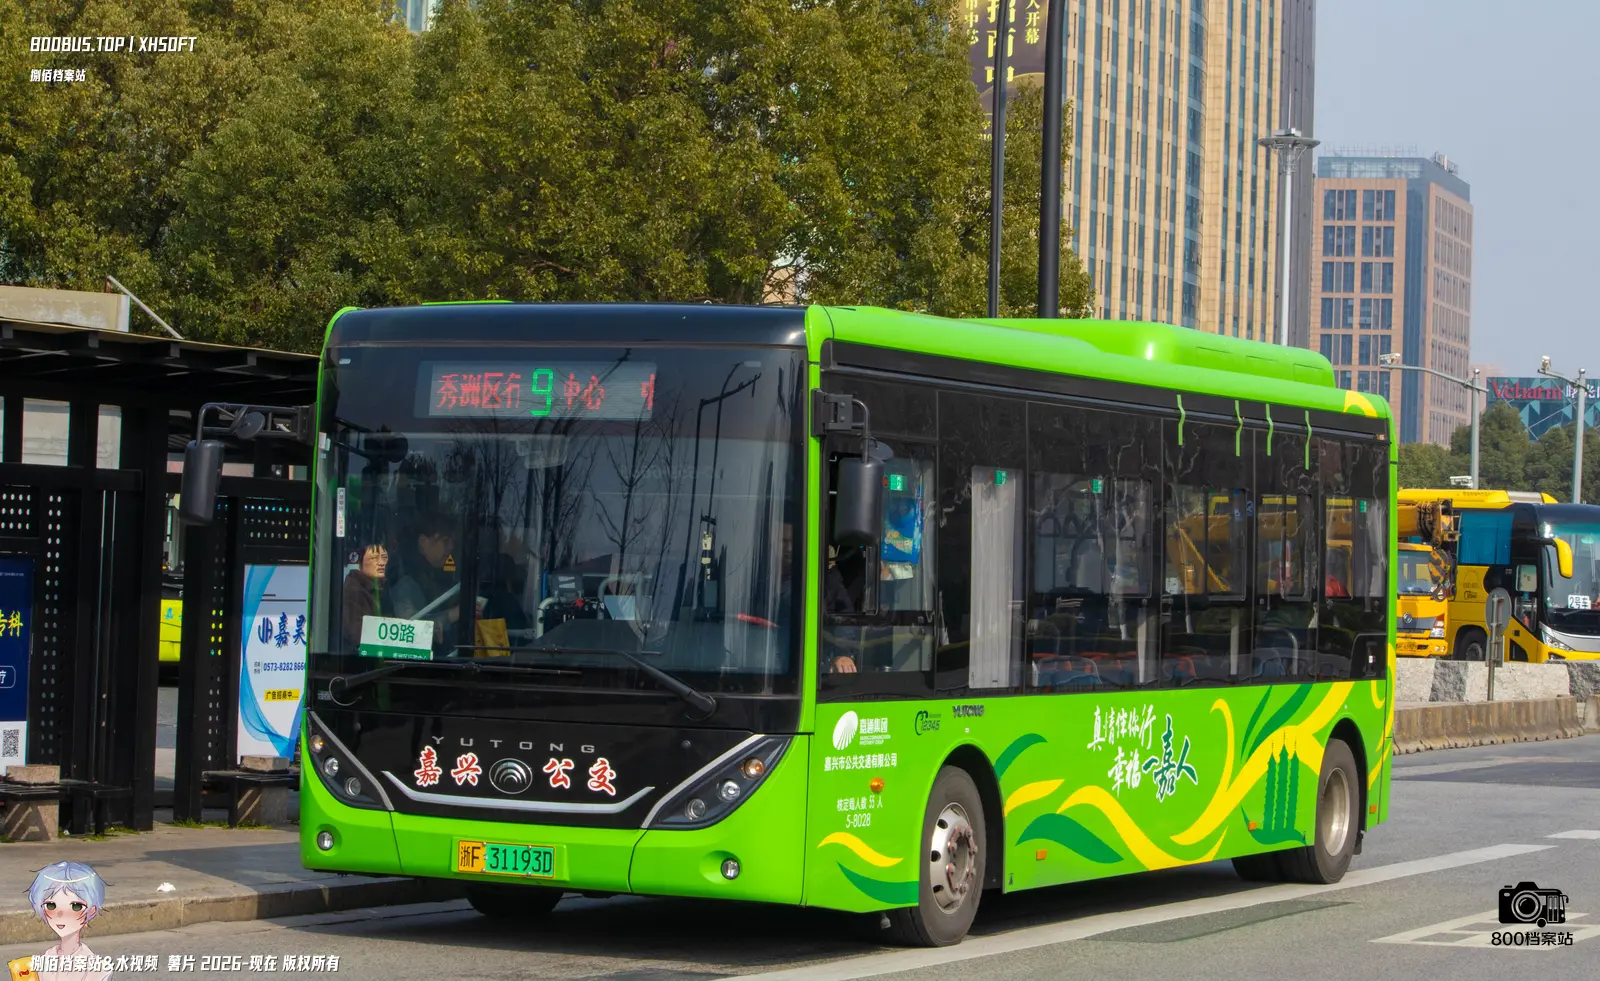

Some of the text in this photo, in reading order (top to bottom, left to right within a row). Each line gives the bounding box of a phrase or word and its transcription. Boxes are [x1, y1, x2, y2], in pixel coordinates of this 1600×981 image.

[530, 368, 553, 416] 9
[564, 373, 604, 410] 中心
[1491, 380, 1563, 400] Vcharm
[378, 622, 415, 643] 09路
[263, 662, 293, 671] 0573-8282
[920, 720, 941, 731] 12345
[432, 736, 595, 753] YUTONG
[414, 745, 616, 796] 嘉兴 公交
[824, 753, 897, 771] 嘉兴市公共交通有限公司
[846, 812, 871, 829] 5-8028
[459, 844, 553, 873] 浙F 31193D
